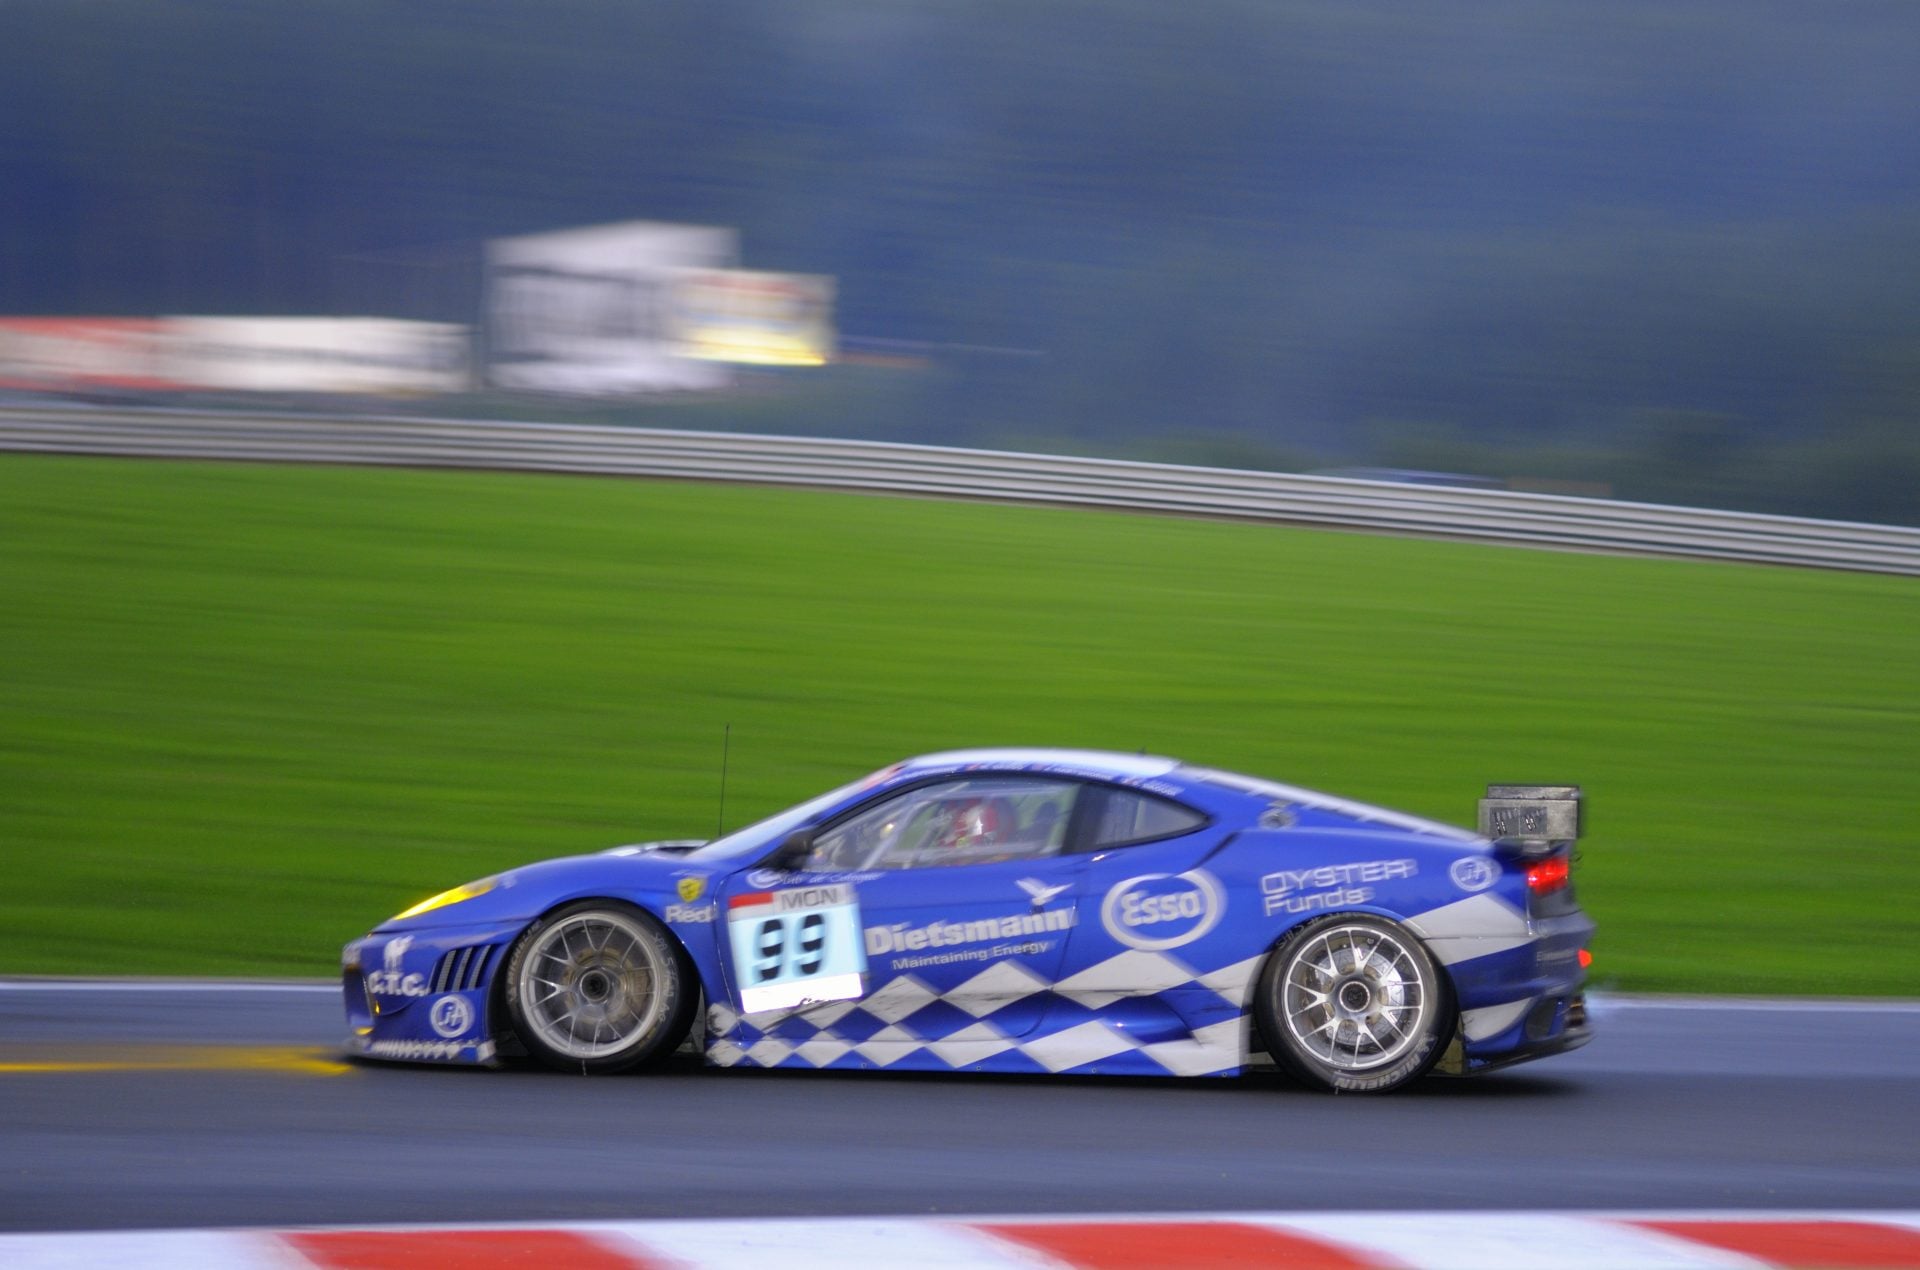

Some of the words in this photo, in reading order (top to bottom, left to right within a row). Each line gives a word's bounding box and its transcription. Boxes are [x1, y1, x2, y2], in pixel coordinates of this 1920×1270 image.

[1261, 859, 1418, 896] OYSTER
[781, 888, 838, 910] MON
[1264, 886, 1375, 916] Funds
[753, 913, 827, 985] 99
[864, 907, 1077, 957] Dietsmann
[892, 947, 989, 970] Maintaining
[992, 939, 1056, 957] Energy
[1334, 1053, 1423, 1090] MICHELIN
